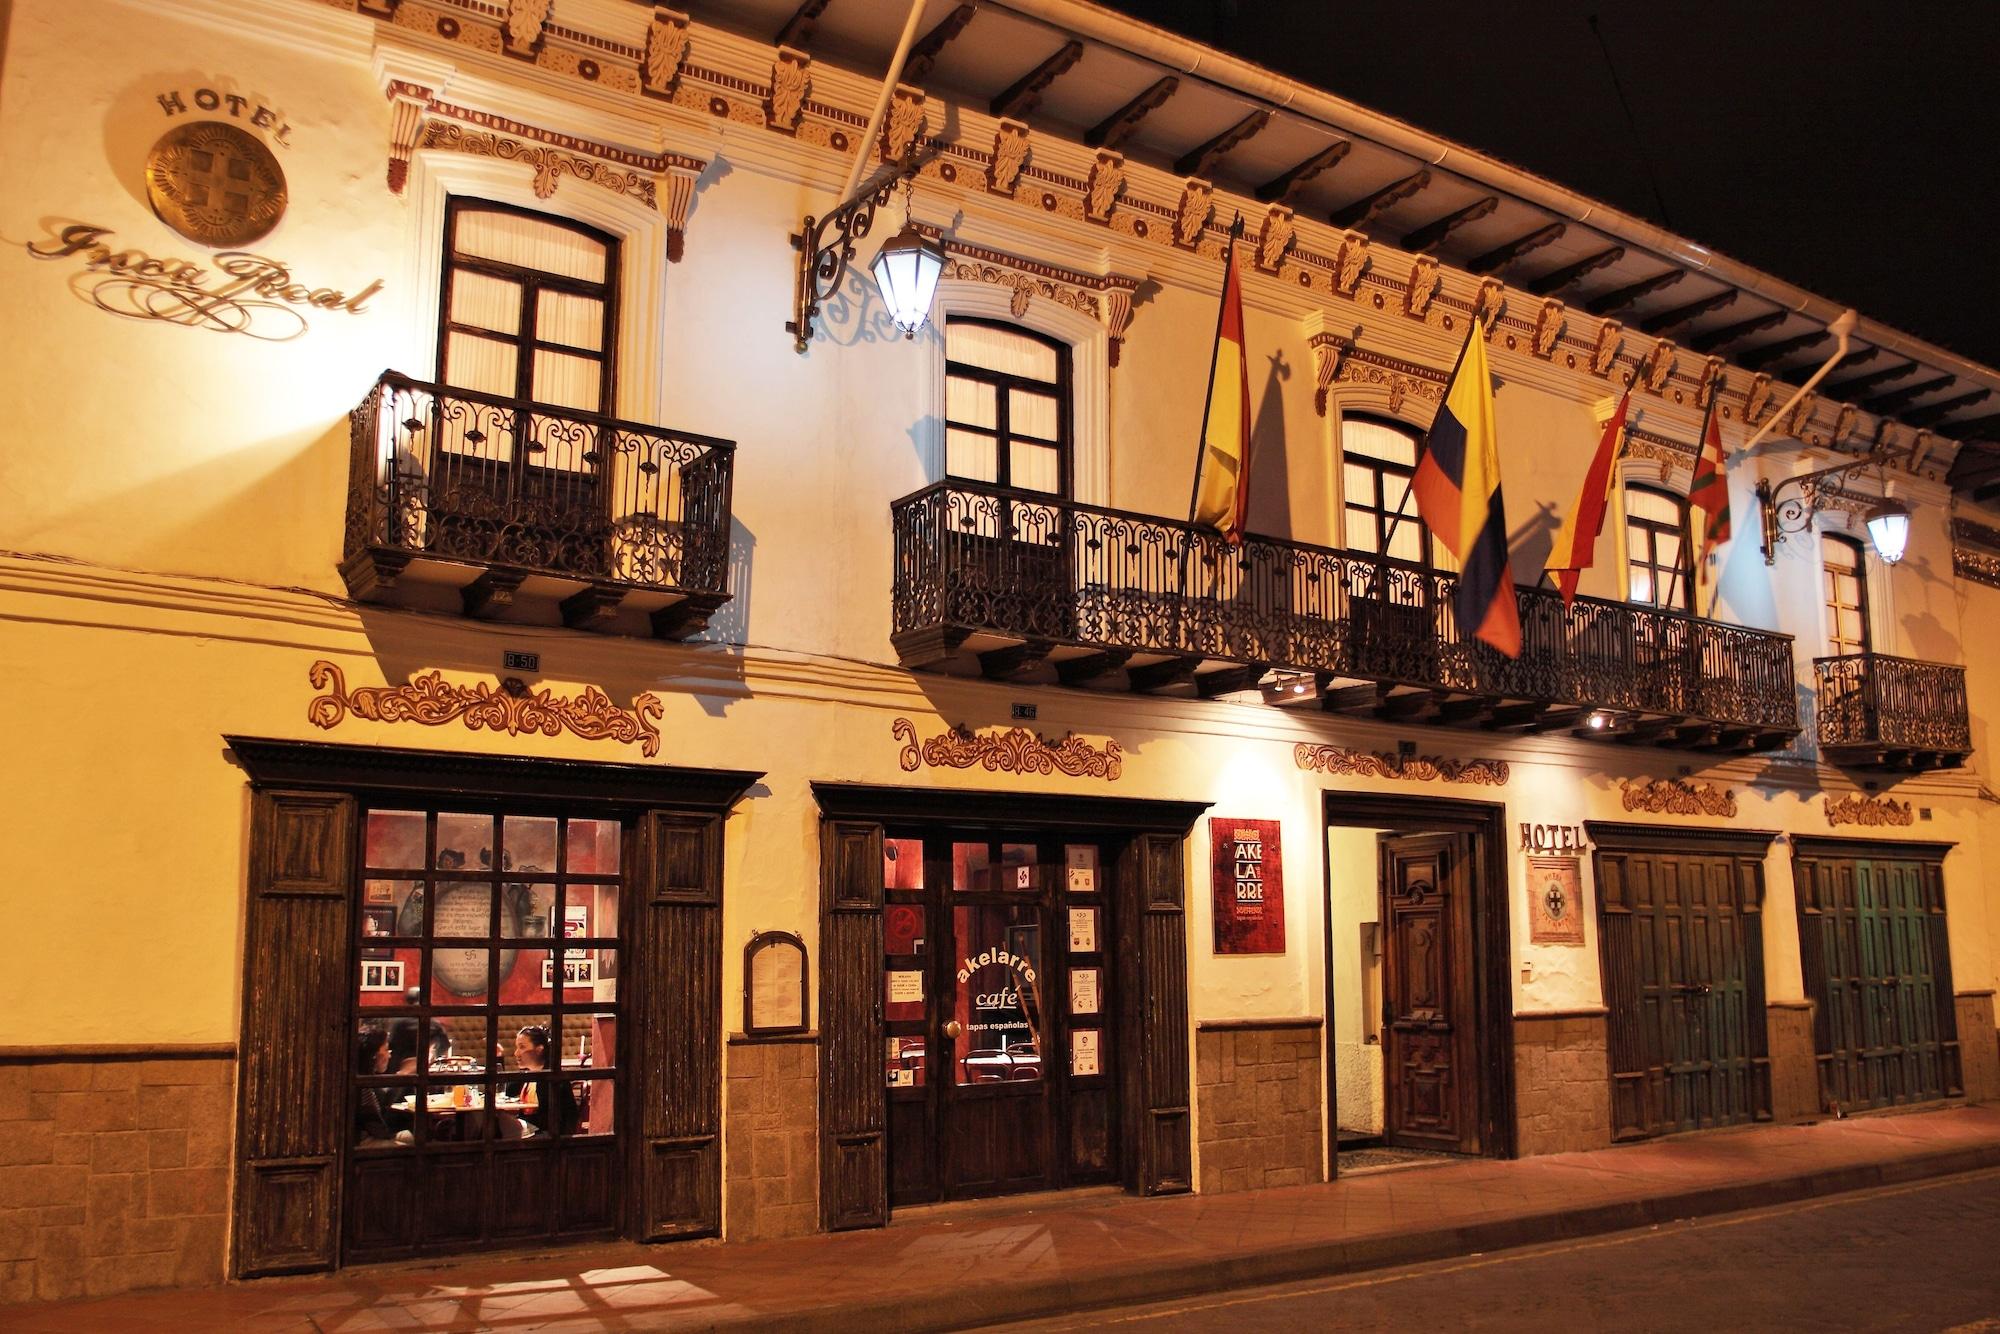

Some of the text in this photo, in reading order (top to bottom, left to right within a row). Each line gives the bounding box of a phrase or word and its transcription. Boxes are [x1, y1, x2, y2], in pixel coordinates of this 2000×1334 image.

[157, 88, 292, 149] HOTEL
[26, 223, 210, 286] Inca
[1519, 822, 1587, 851] HOTEL
[1234, 844, 1262, 859] AKE
[1235, 863, 1257, 879] LA
[1236, 882, 1263, 899] RRE
[957, 947, 1036, 983] akelarre
[976, 984, 1021, 1009] café
[966, 1021, 1029, 1032] tapas españolas
